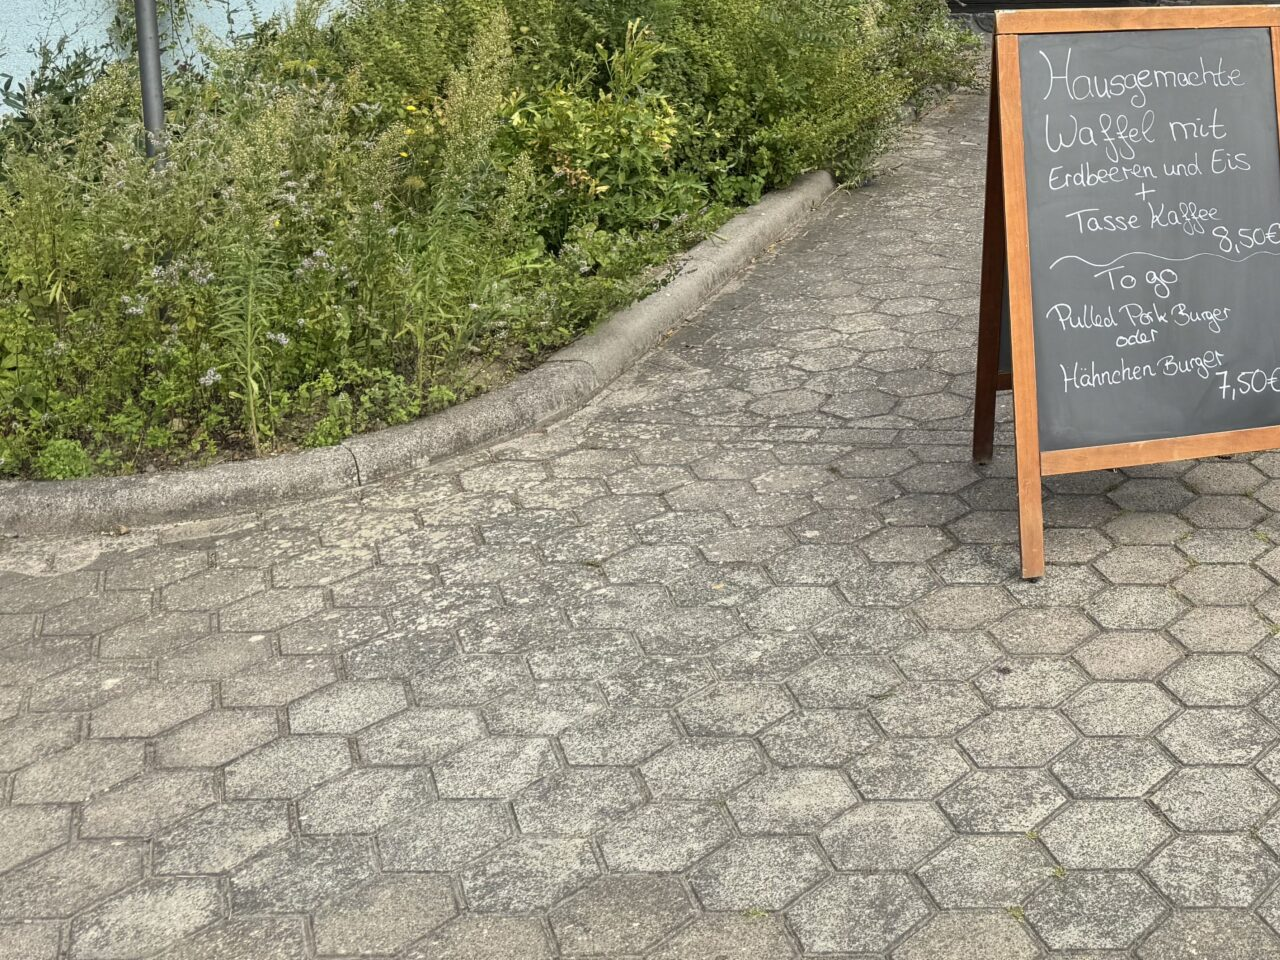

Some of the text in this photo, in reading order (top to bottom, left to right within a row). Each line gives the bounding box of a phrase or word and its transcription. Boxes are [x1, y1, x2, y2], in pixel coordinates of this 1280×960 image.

[1039, 47, 1246, 108] Hausgemachte
[1045, 107, 1228, 163] Waffel mit
[1049, 147, 1251, 191] Erdbeeren und Eis
[1065, 202, 1223, 236] Tasse Kaffee
[1093, 265, 1178, 299] To go
[1046, 302, 1232, 334] Pulled Pork Burger
[1115, 328, 1159, 348] oder
[1059, 349, 1225, 393] Hähnchen Burger
